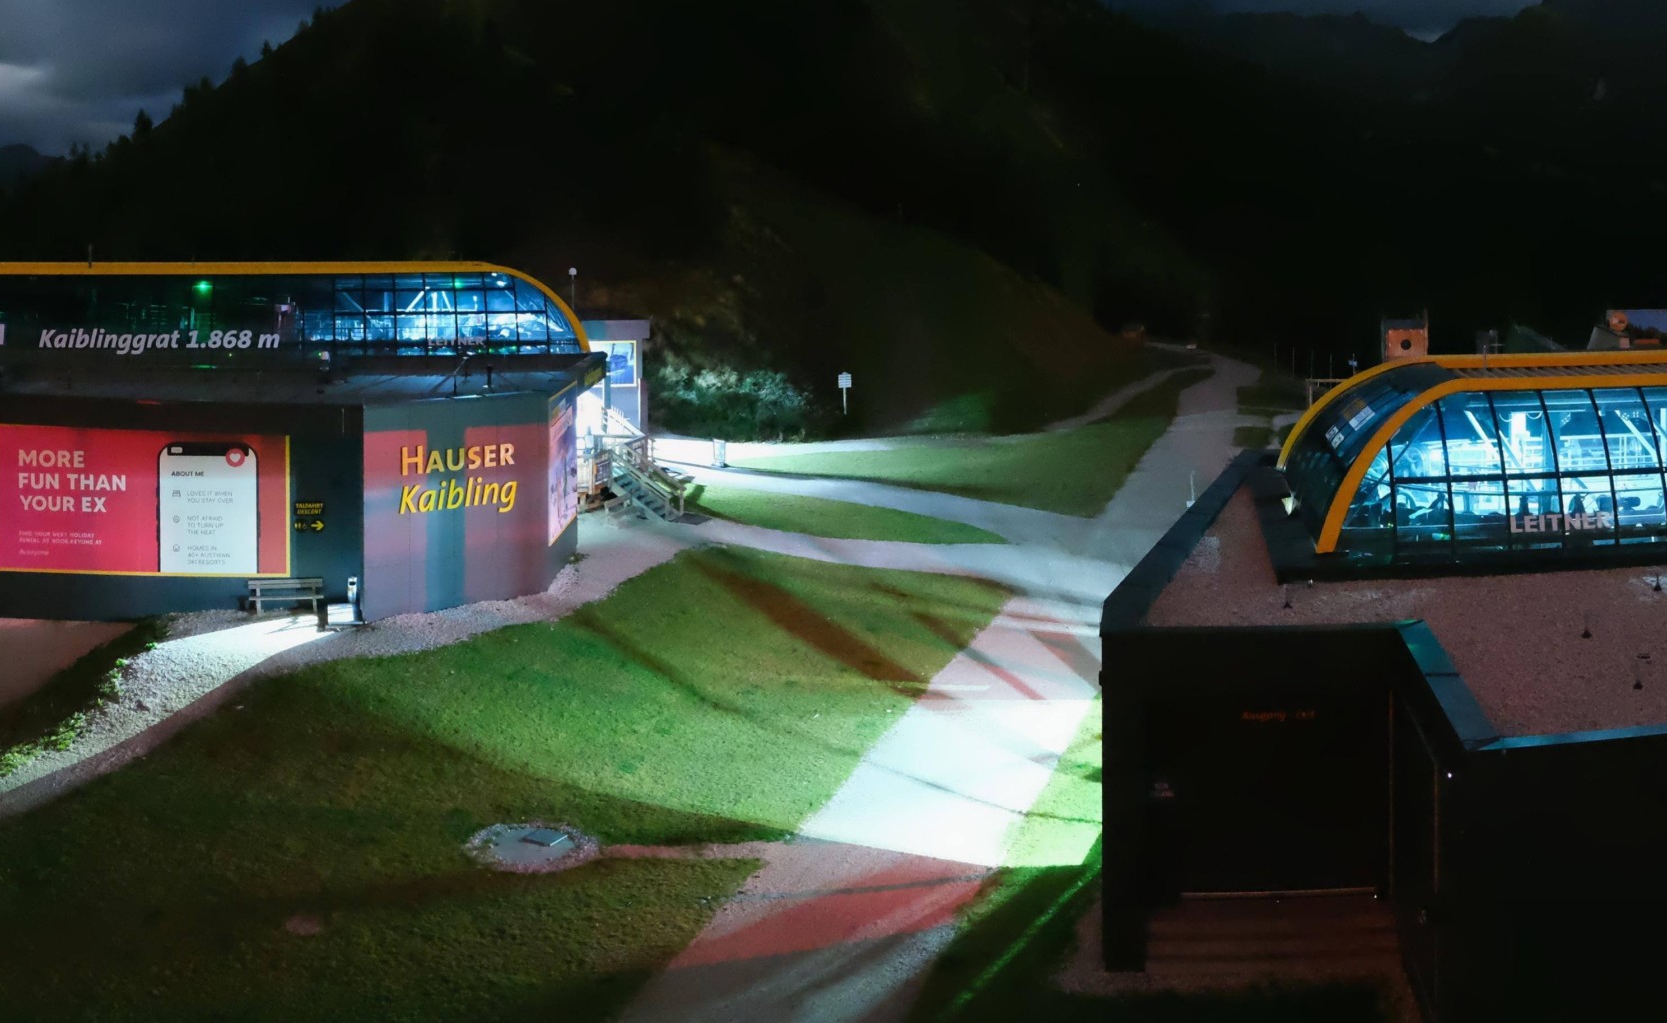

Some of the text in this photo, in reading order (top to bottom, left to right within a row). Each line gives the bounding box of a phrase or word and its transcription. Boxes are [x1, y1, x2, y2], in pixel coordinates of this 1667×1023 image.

[38, 328, 280, 355] Kaiblinggrat 1.868 m
[18, 449, 85, 468] MORE
[401, 443, 515, 476] HAUSER
[18, 472, 126, 491] FUN THAN
[20, 495, 107, 513] YOUR EX
[399, 477, 518, 515] Kaibling
[1510, 511, 1612, 533] LEITNER
